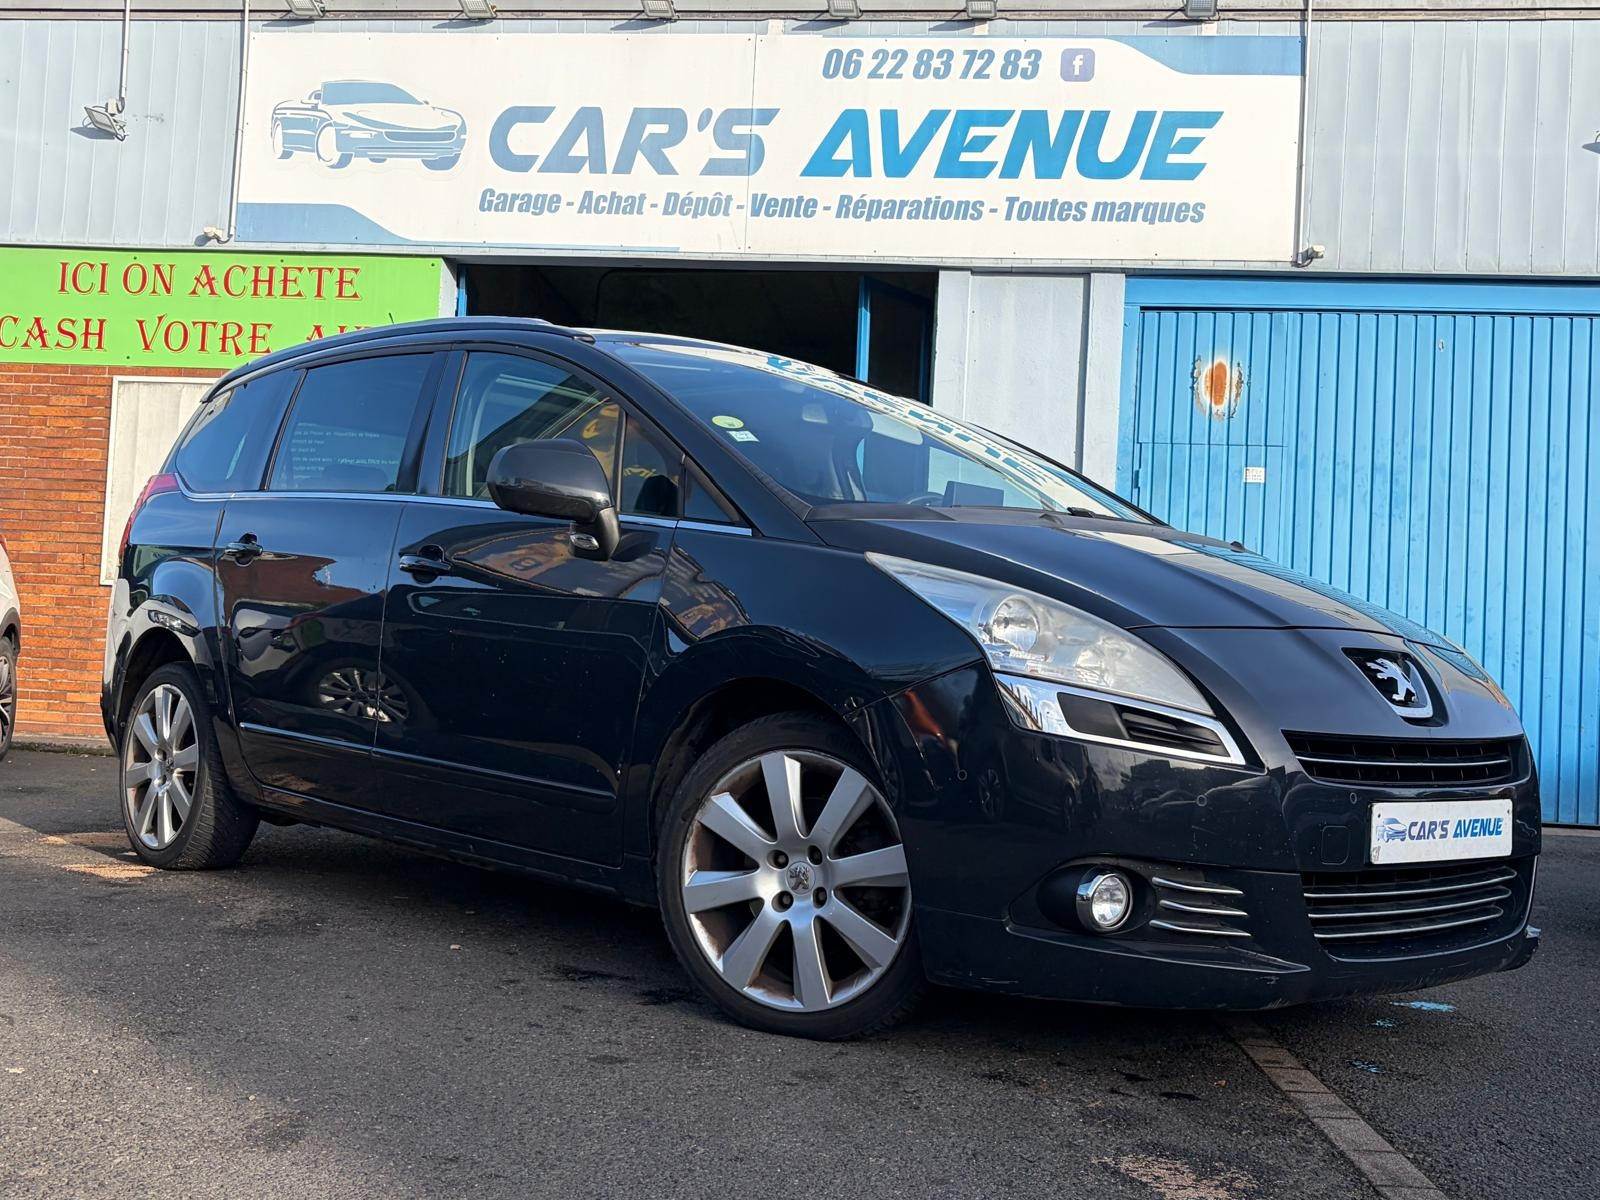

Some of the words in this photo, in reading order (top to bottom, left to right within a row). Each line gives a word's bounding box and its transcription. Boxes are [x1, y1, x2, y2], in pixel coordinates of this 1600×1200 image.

[822, 49, 864, 79] 06
[868, 49, 908, 79] 22
[913, 49, 955, 80] 83
[959, 49, 996, 79] 72
[1000, 49, 1042, 80] 83
[488, 106, 780, 176] CAR'S
[800, 109, 1223, 180] AVENUE
[479, 188, 561, 216] Garage
[577, 191, 646, 215] Achat
[662, 191, 733, 218] Dépôt
[751, 193, 818, 218] Vente
[835, 194, 984, 222] Réparations
[1005, 197, 1087, 222] Toutes
[1091, 201, 1205, 225] marques
[59, 262, 108, 296] ICI
[123, 264, 176, 296] ON
[190, 266, 361, 299] ACHETE
[0, 316, 107, 351] CASH
[136, 315, 273, 355] VOTRE
[1408, 820, 1449, 840] CAR'S
[1453, 816, 1503, 840] AVENUE
